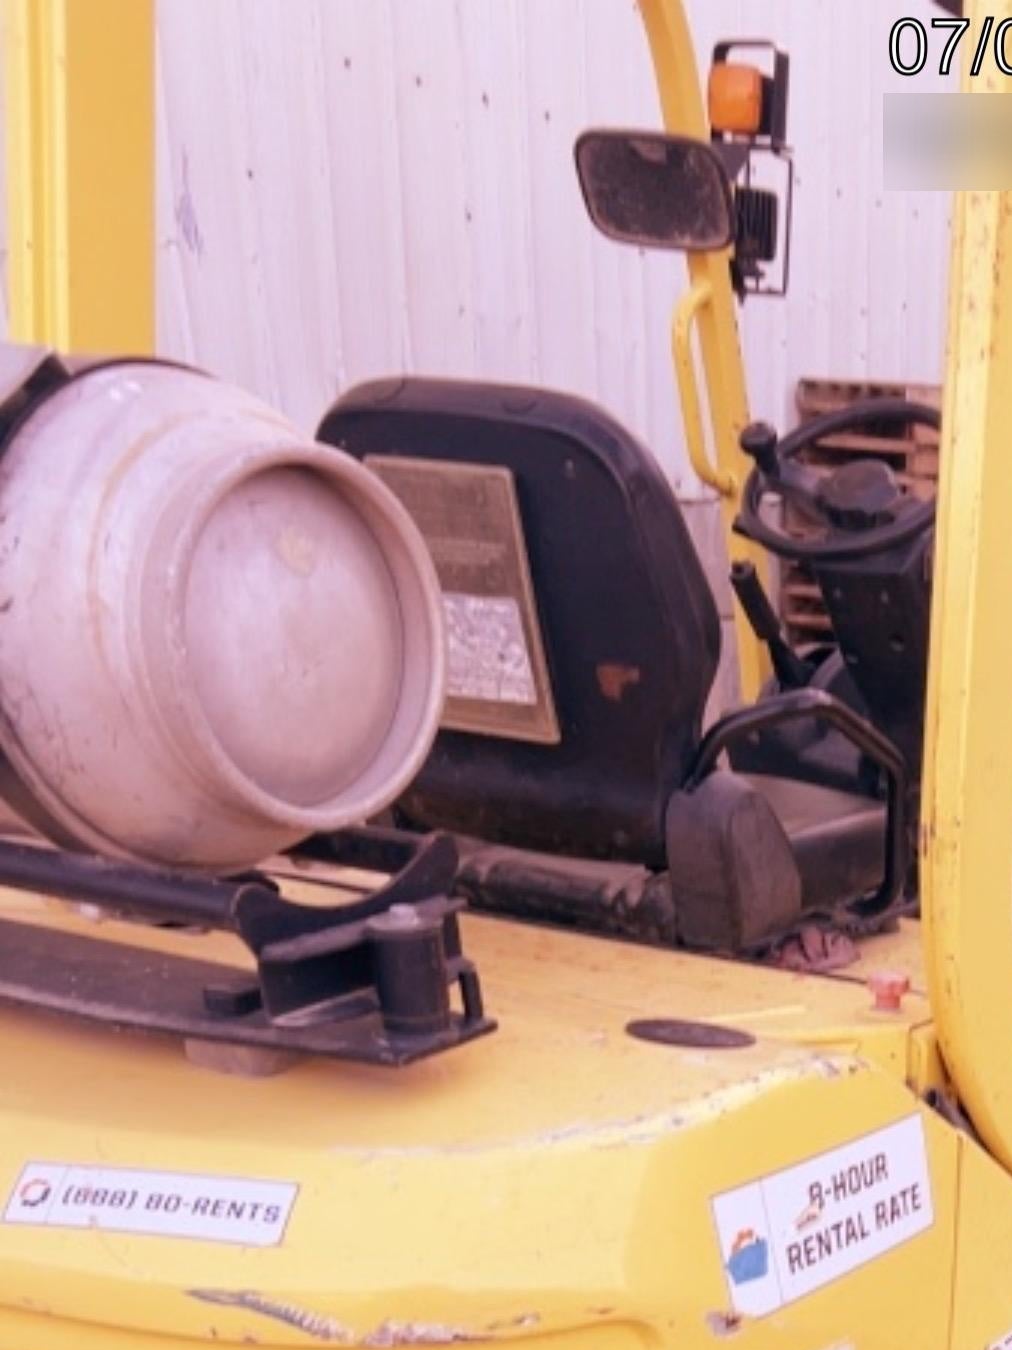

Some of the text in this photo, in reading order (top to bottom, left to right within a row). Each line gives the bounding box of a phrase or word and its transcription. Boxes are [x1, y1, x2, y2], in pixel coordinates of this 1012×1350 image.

[61, 1183, 282, 1224] (888) 80-RENTS
[786, 1182, 923, 1275] RENTAL RATE
